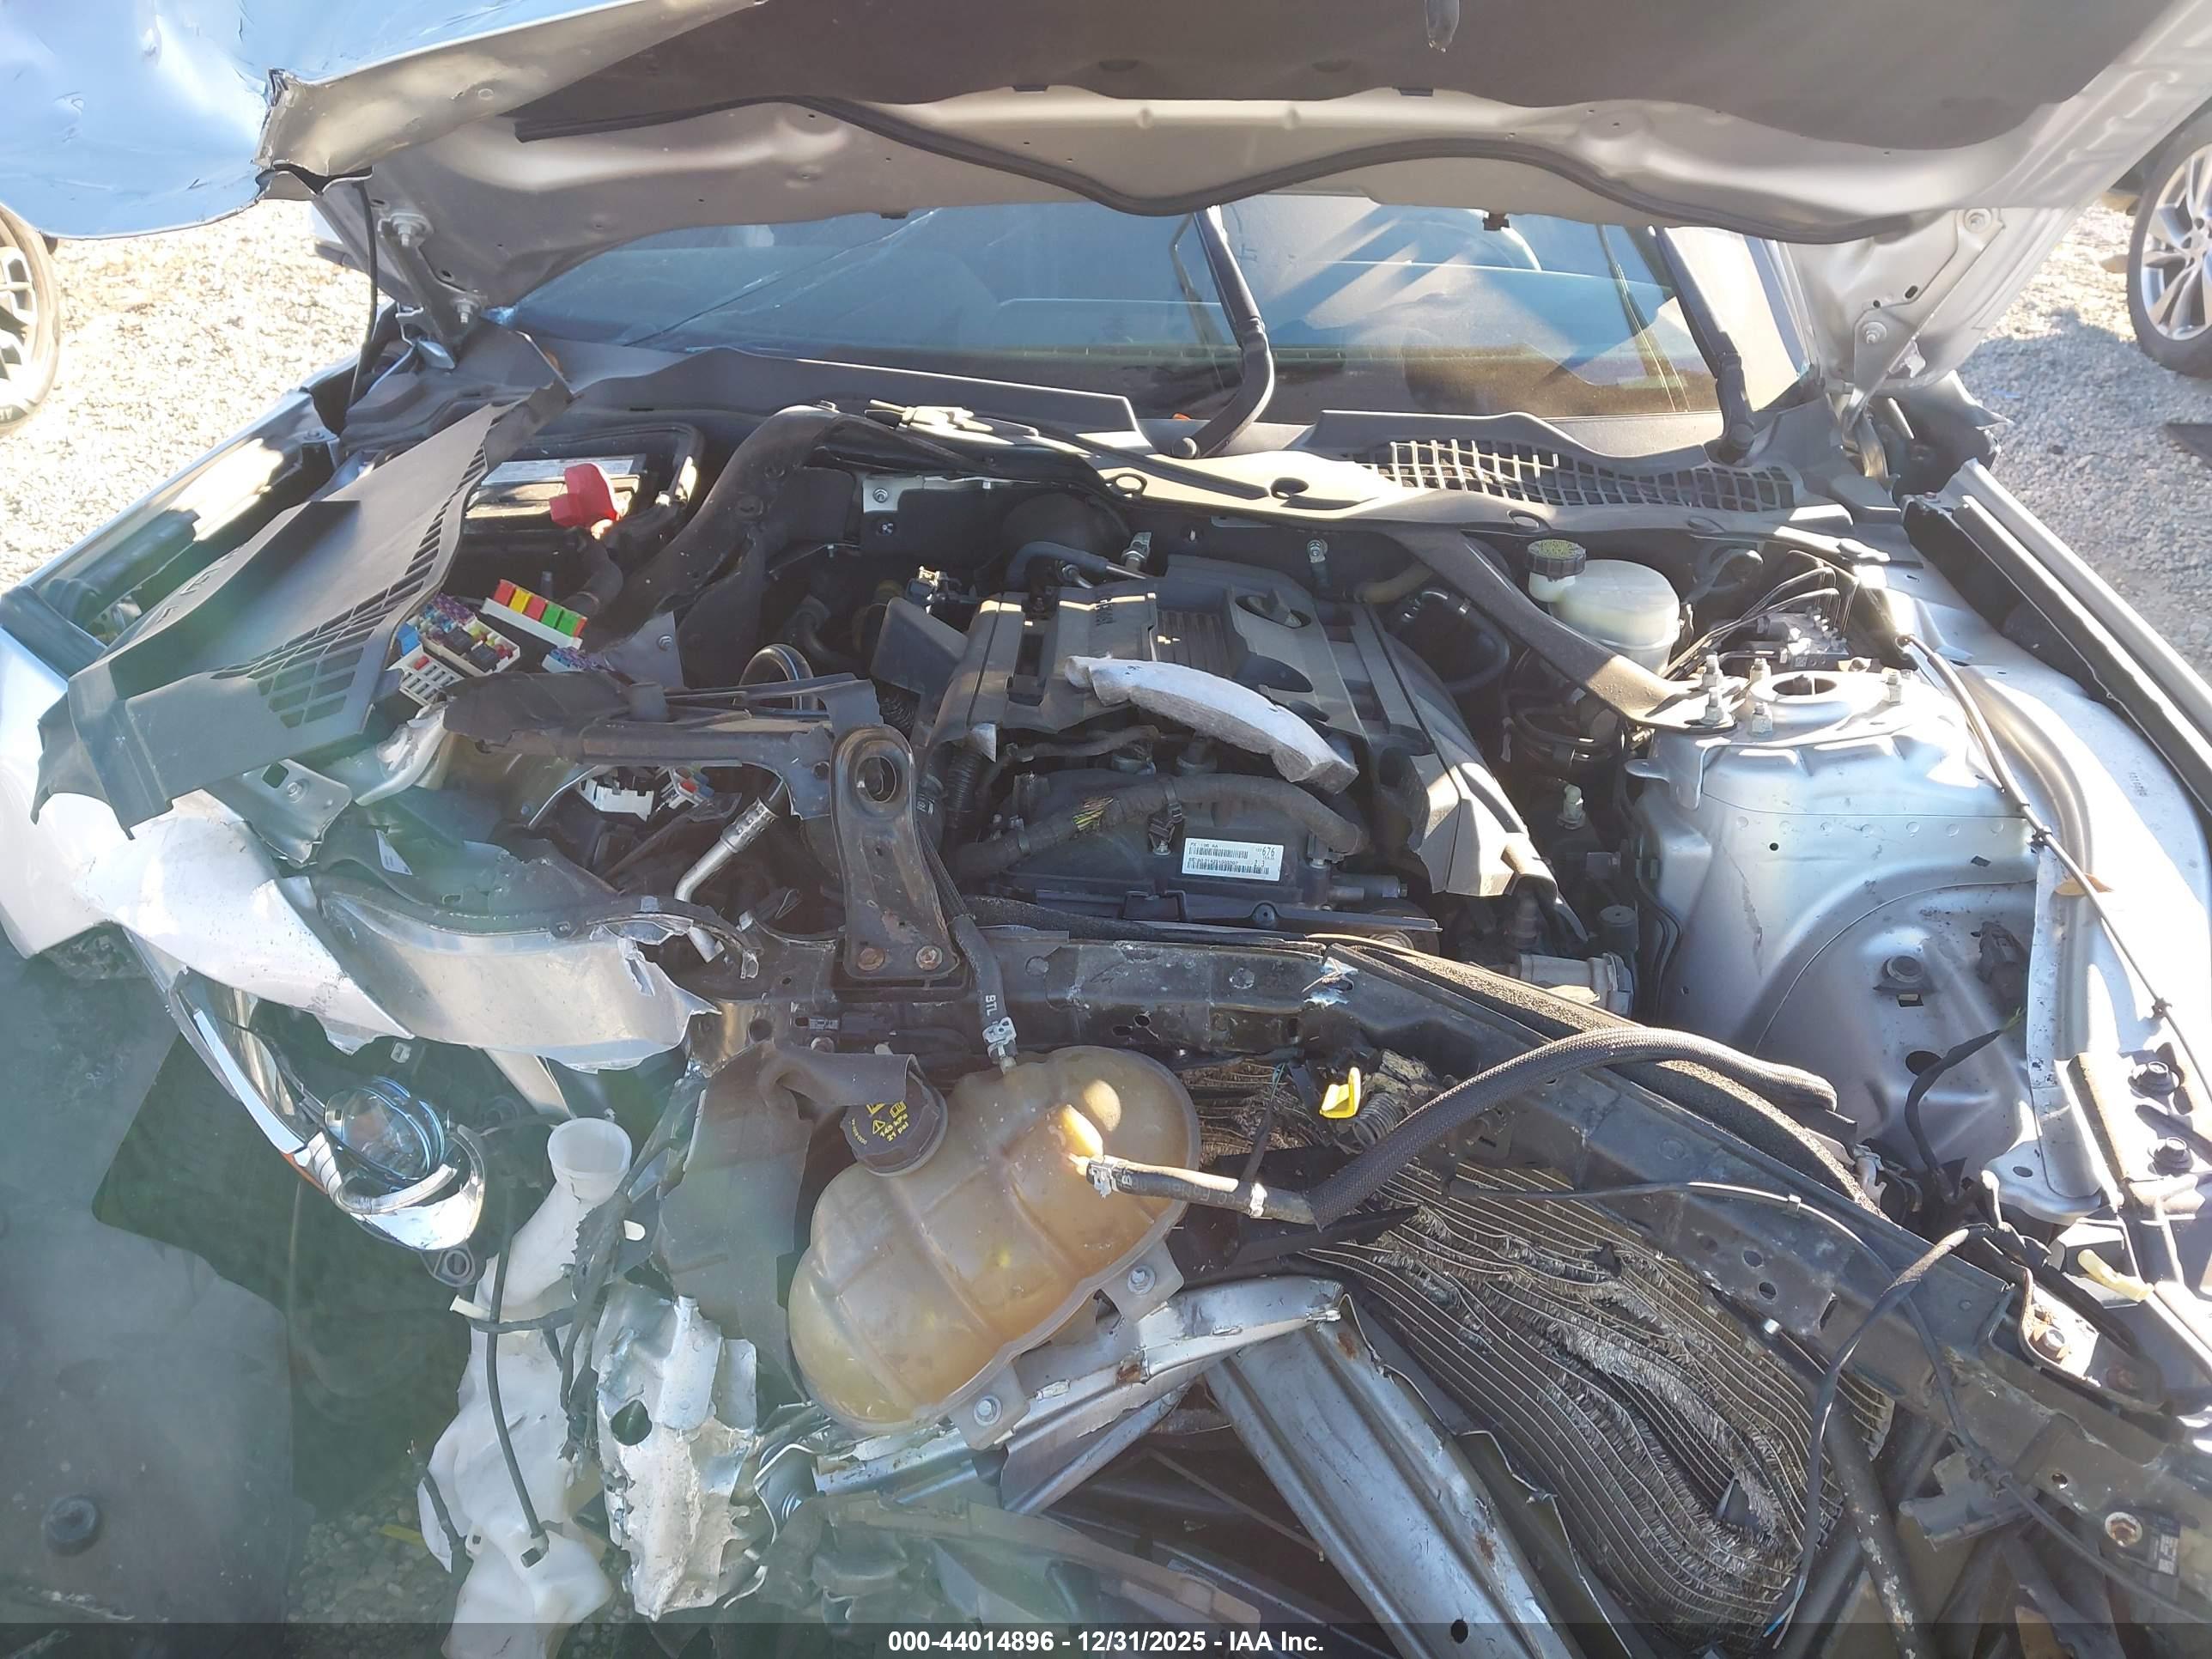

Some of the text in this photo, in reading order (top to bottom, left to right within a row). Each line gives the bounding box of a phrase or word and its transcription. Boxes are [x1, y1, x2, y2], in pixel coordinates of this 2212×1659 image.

[1261, 846, 1275, 857] 676
[886, 1121, 909, 1142] 21 psi
